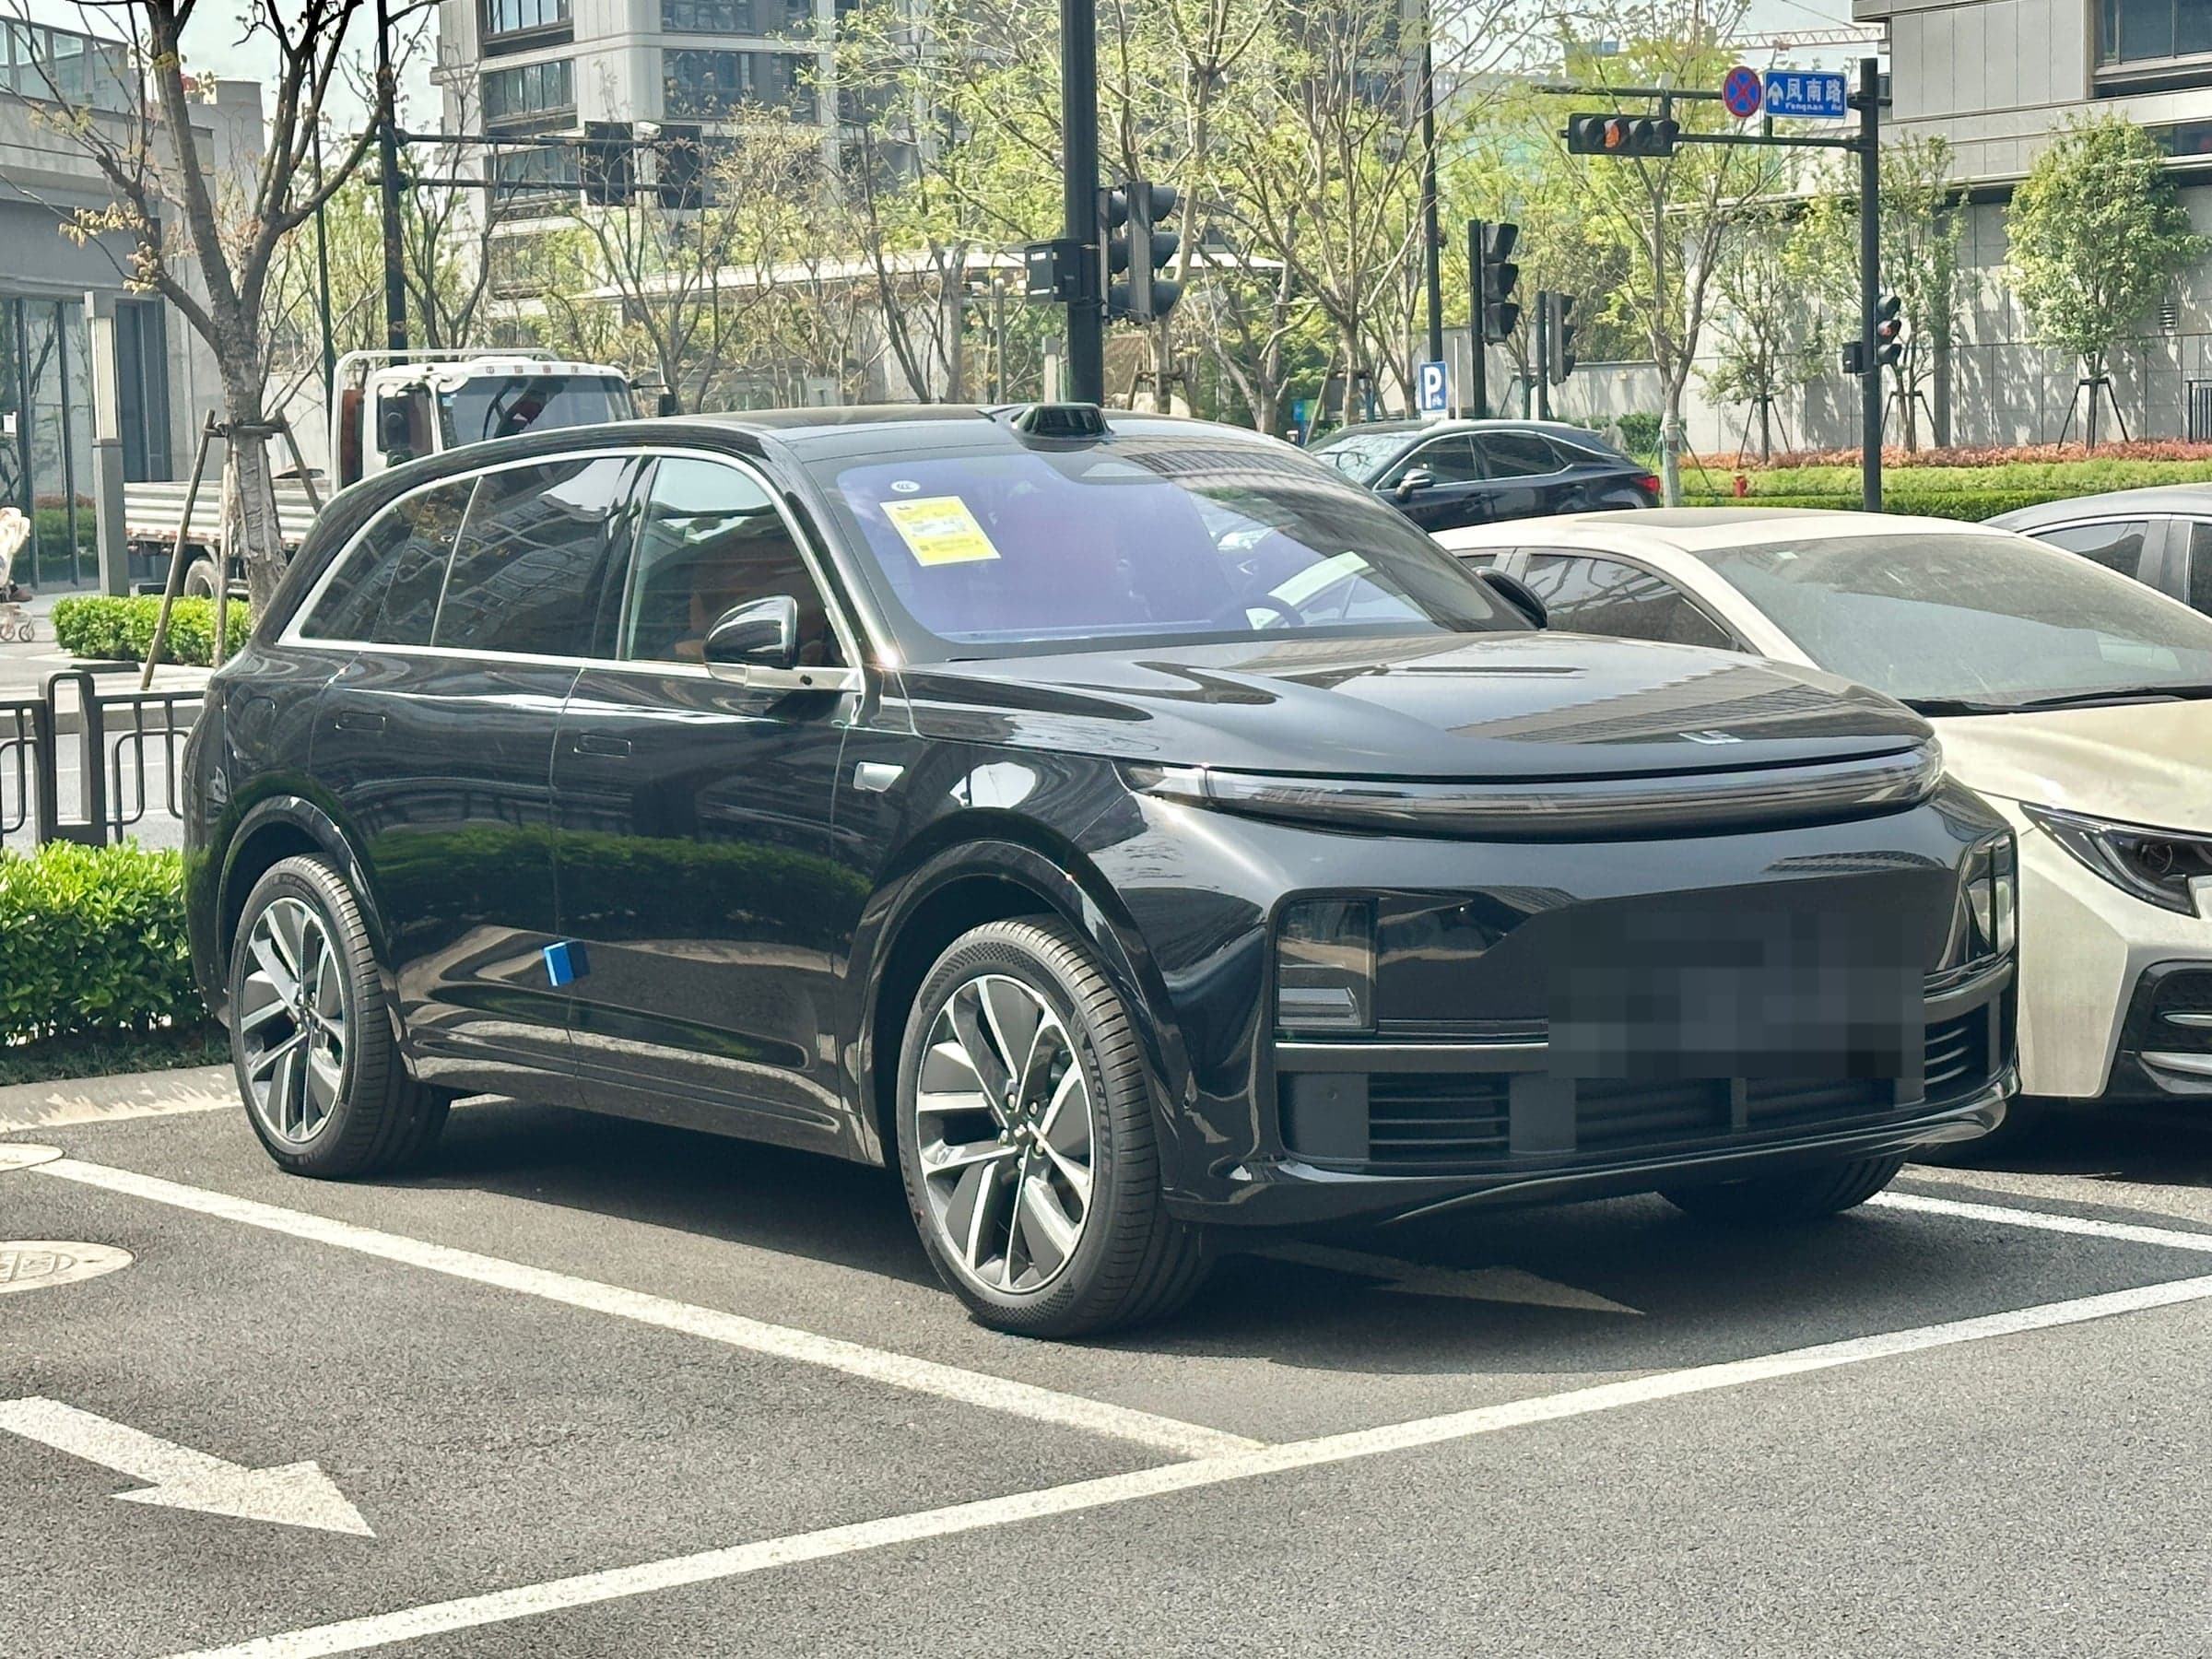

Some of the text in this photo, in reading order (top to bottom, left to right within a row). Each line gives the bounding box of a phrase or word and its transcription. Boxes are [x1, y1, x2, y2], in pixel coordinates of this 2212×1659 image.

[1785, 102, 1824, 112] Fengnan
[1786, 77, 1841, 103] 凤南路
[1424, 366, 1441, 409] P
[1083, 1048, 1112, 1176] MICHELIN
